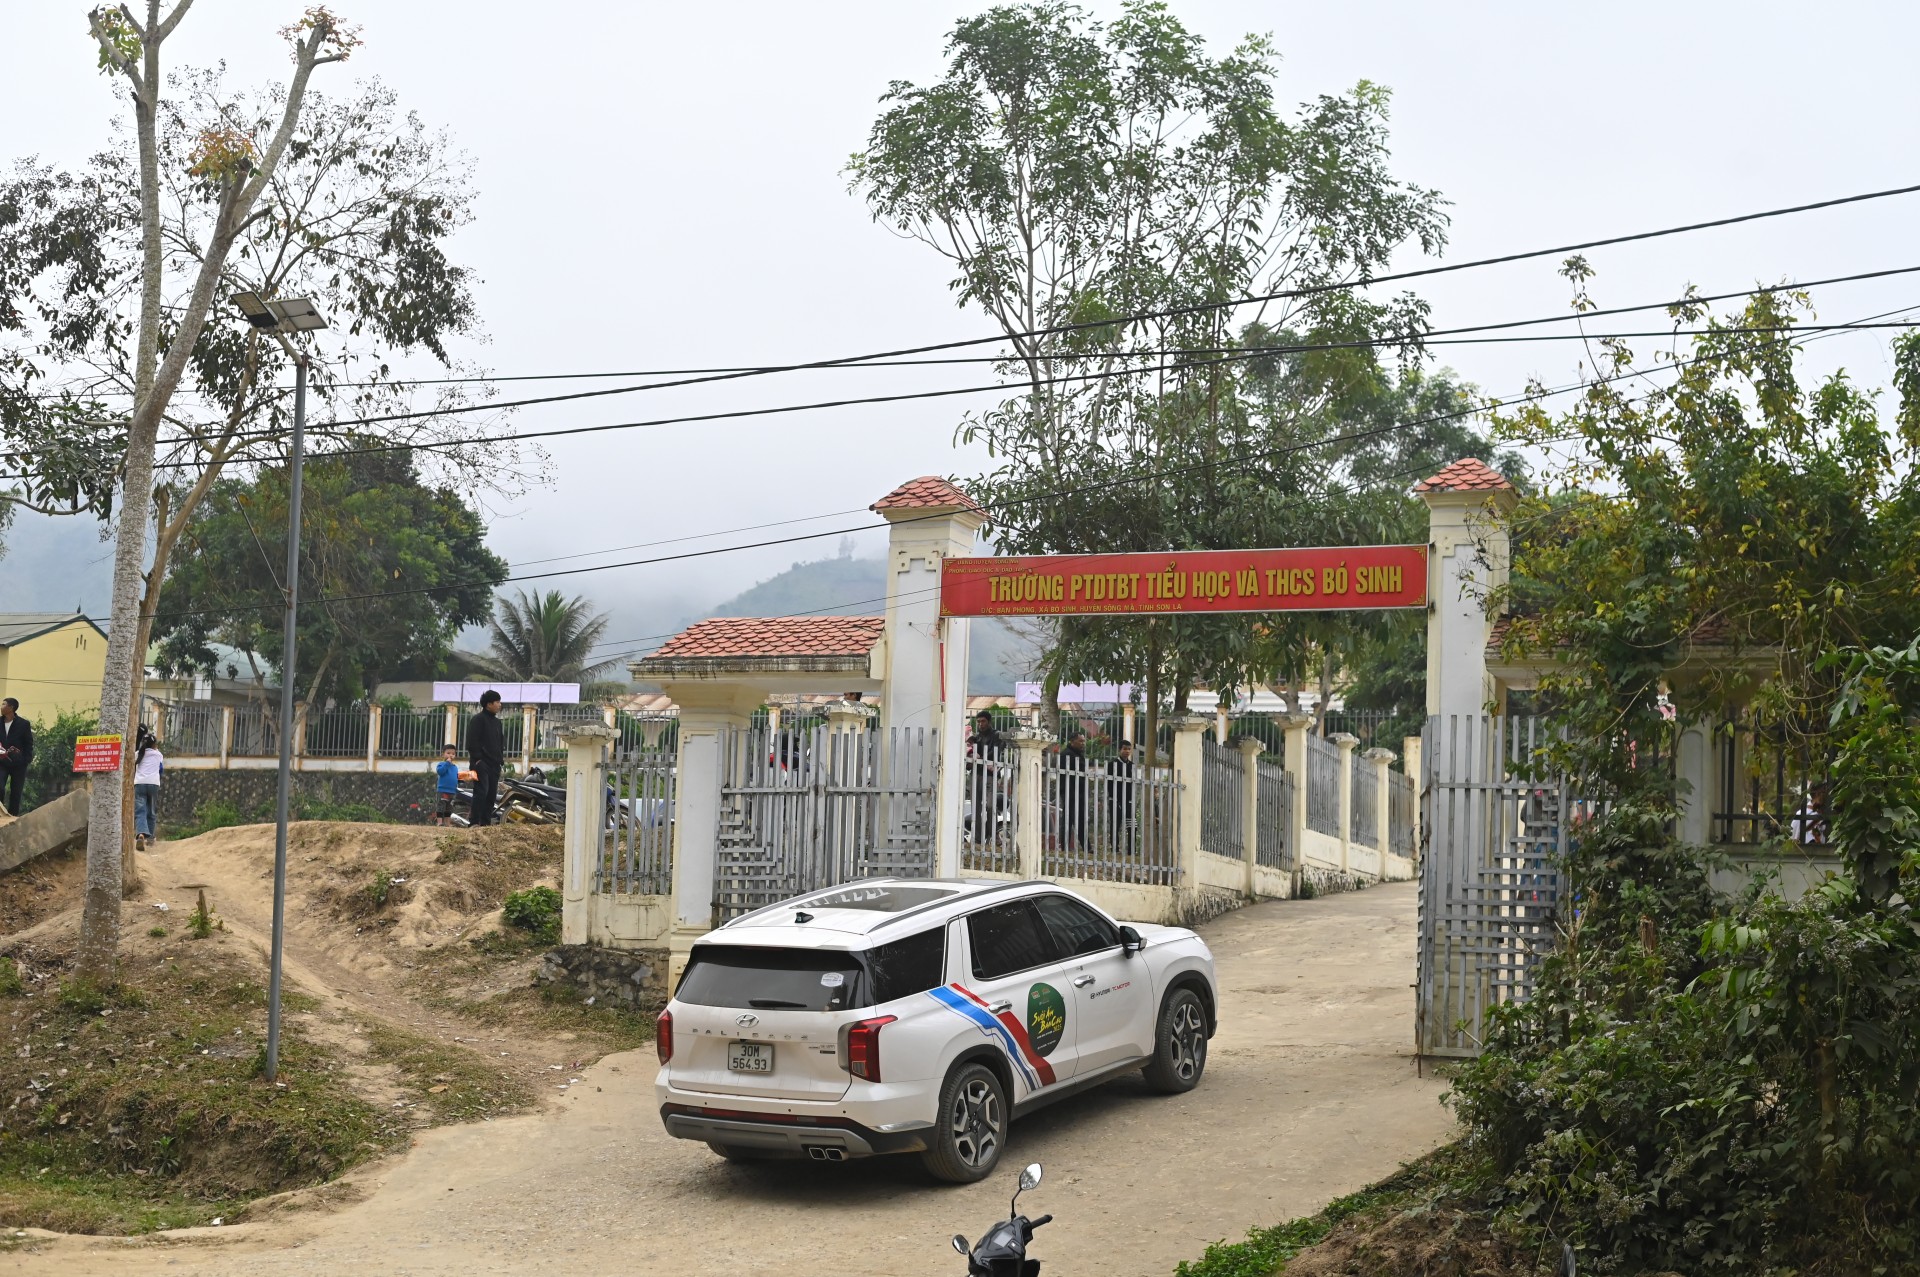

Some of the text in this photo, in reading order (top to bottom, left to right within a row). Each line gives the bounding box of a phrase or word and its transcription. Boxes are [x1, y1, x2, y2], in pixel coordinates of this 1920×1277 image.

[988, 560, 1403, 603] TRƯỜNG PTDTBT TIỂU HỌC VÀ THCS BÓ SINH
[1050, 603, 1060, 613] BÓ
[1103, 603, 1122, 612] SÔNG
[740, 1045, 760, 1057] 30M
[732, 1057, 767, 1070] 564.93
